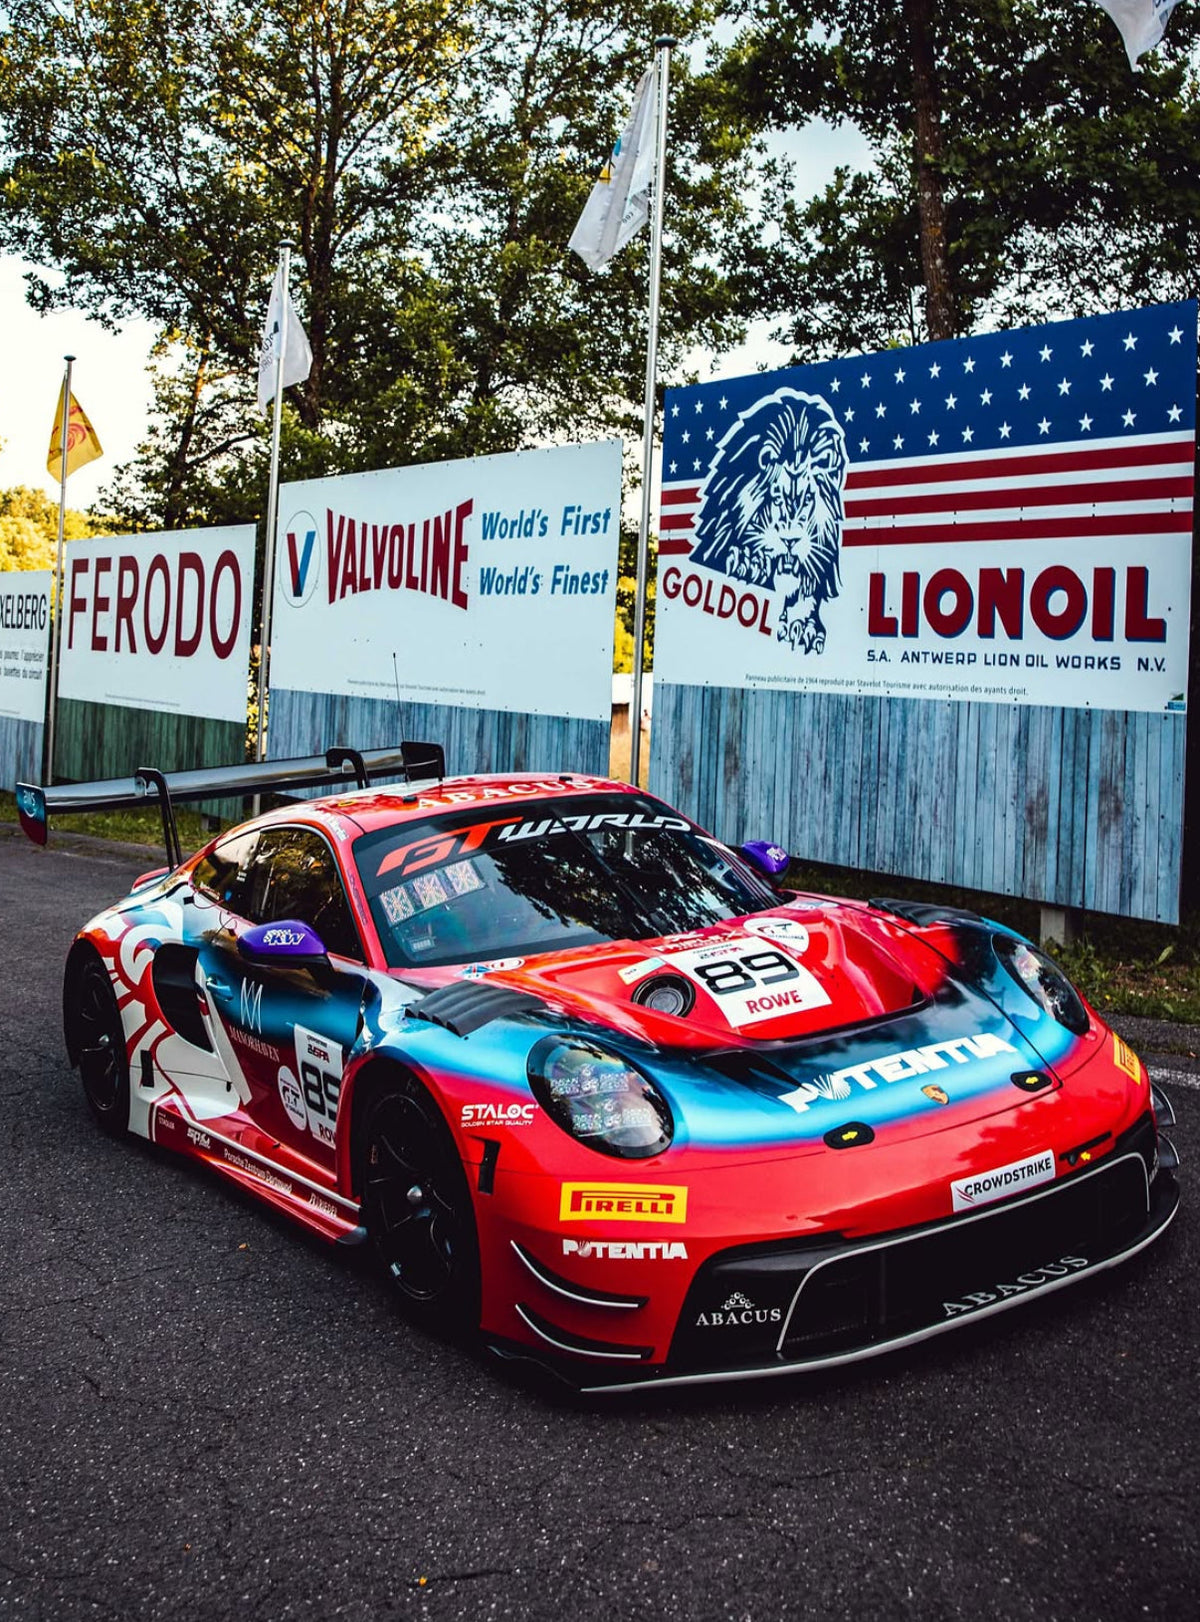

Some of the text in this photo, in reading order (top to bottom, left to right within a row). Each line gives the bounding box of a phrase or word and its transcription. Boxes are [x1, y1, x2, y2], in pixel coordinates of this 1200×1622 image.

[481, 506, 611, 540] World's First
[327, 498, 474, 611] VALVOLINE
[479, 565, 609, 595] World's Finest
[68, 550, 242, 660] FERODO
[662, 566, 772, 637] GOLDOL
[868, 565, 1167, 643] LIONOIL
[867, 649, 1166, 673] S.A. ANTWERP LION OIL WORKS N.V.
[883, 680, 911, 690] Tourisme
[912, 683, 927, 691] avec
[928, 682, 969, 692] autorisation
[970, 684, 982, 693] des
[984, 685, 1006, 695] ayants
[417, 780, 593, 810] ABACUS
[375, 815, 523, 877] GT
[497, 813, 691, 843] WORLD
[266, 929, 306, 946] KW
[693, 951, 800, 996] 89
[745, 989, 803, 1015] ROWE
[777, 1032, 1018, 1113] POTENTIA
[461, 1103, 535, 1121] STALOC
[461, 1120, 485, 1128] GOLDEN
[963, 1157, 1052, 1197] CROWDSTRIKE
[570, 1190, 676, 1215] PIRELLI
[562, 1238, 689, 1260] POTENTIA
[941, 1254, 1088, 1318] ABACUS
[696, 1308, 782, 1327] ABACUS
